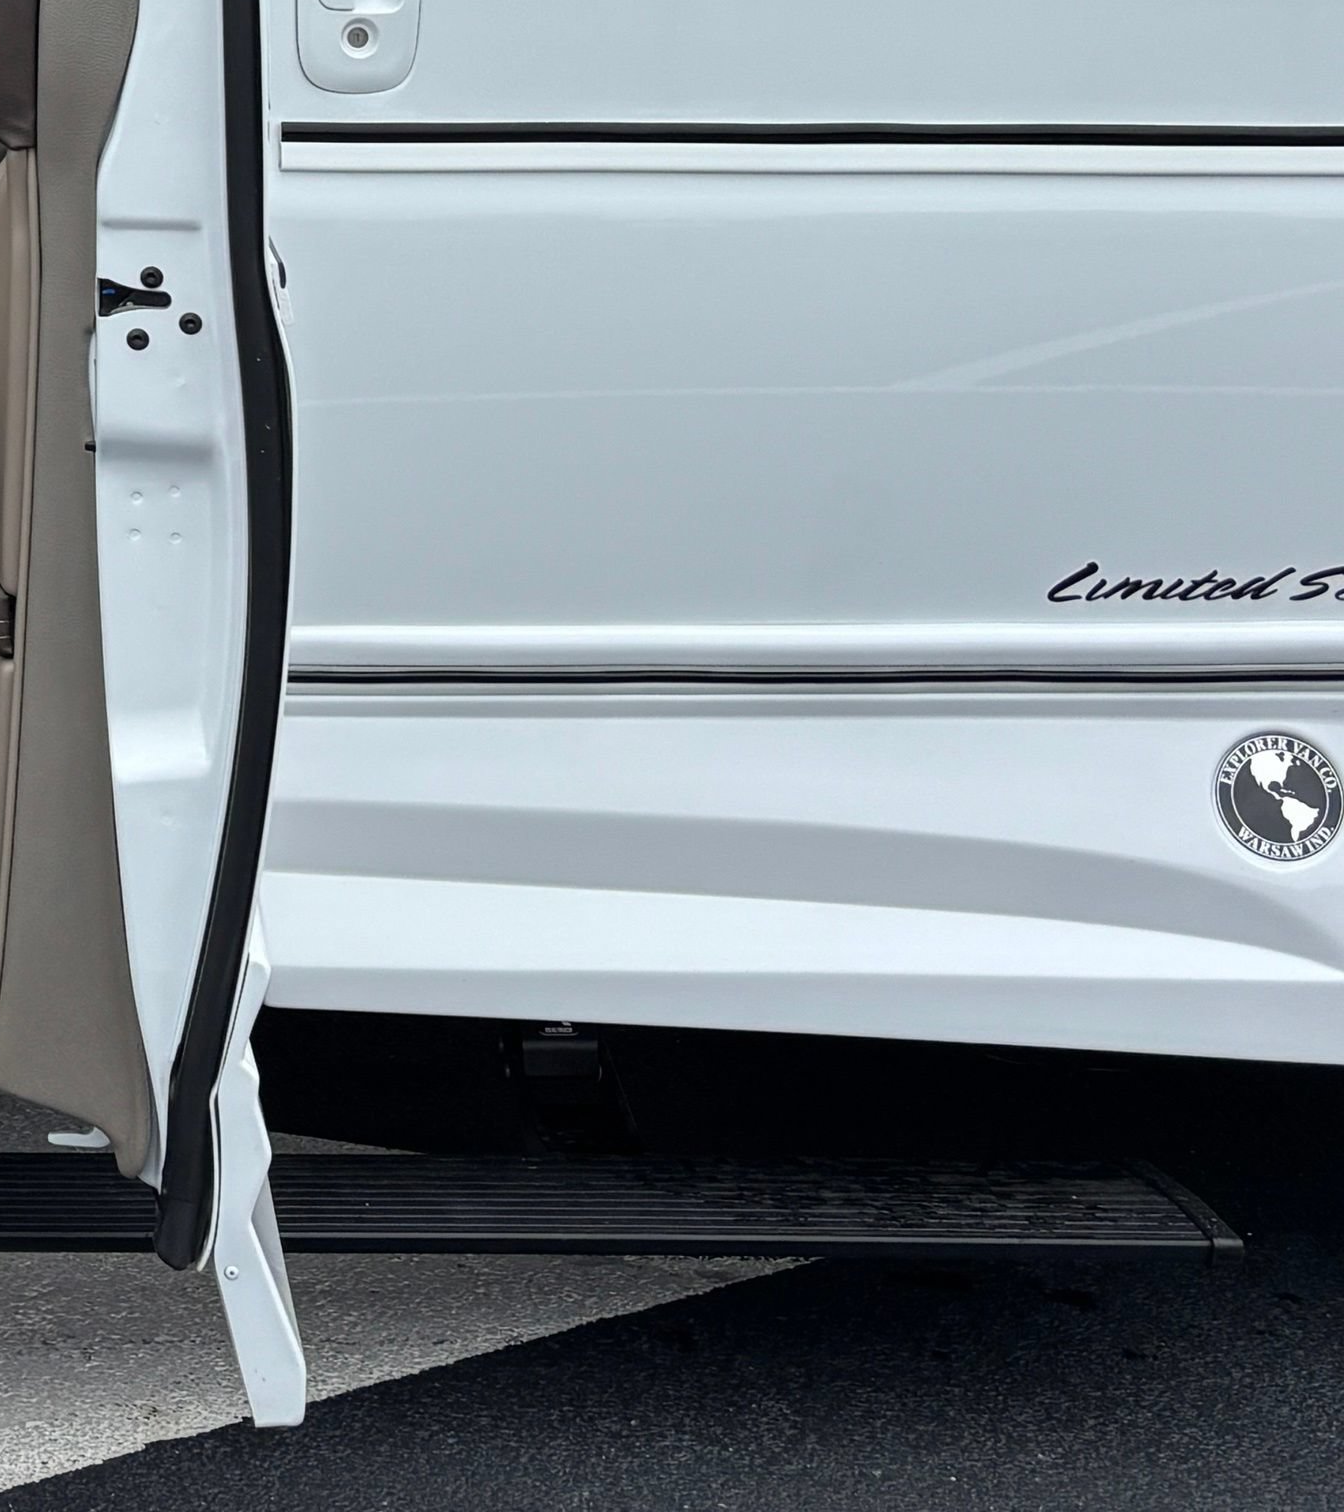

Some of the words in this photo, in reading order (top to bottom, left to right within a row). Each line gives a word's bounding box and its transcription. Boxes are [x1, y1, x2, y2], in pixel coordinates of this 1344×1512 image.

[1047, 561, 1296, 602] Limited
[1220, 736, 1288, 785] EXPLORER
[1293, 742, 1322, 768] VAN
[1320, 767, 1338, 793] CO.
[1238, 826, 1304, 858] WARSAW
[1305, 826, 1335, 852] IND.
